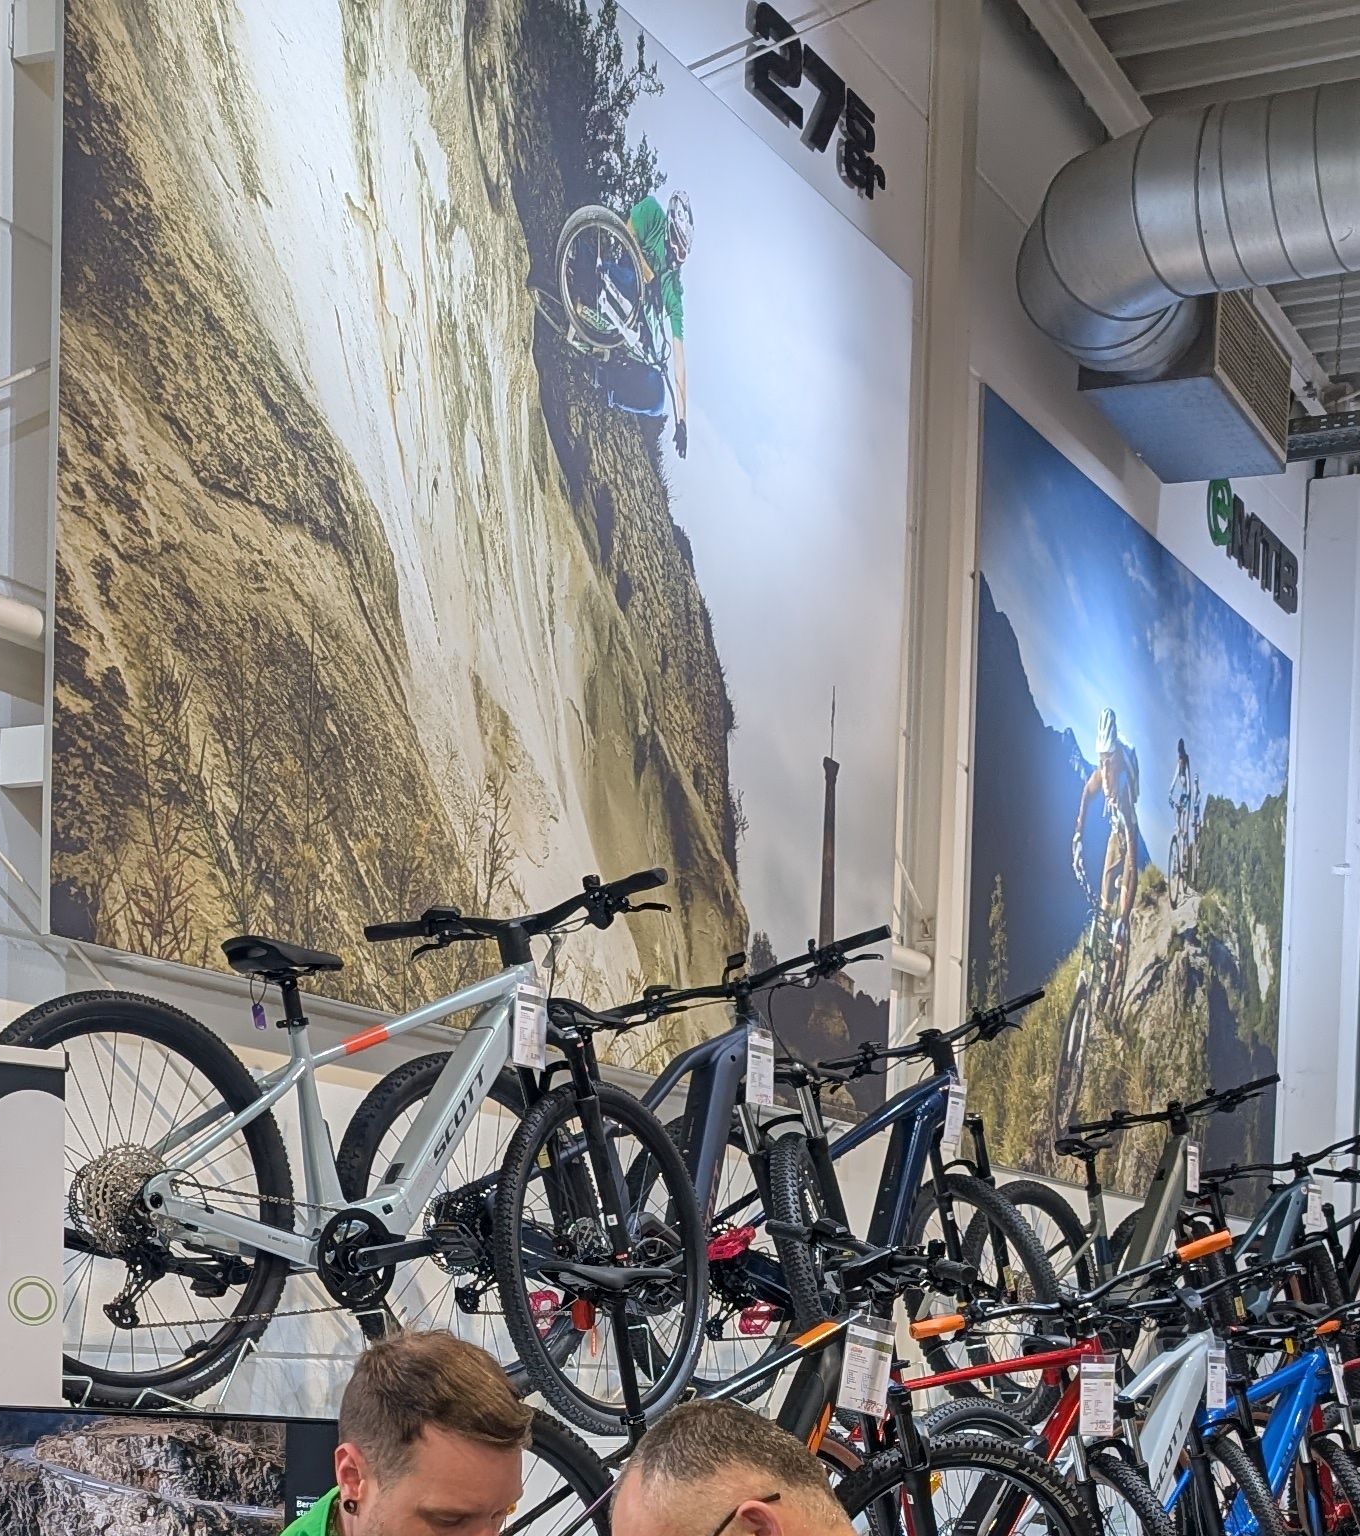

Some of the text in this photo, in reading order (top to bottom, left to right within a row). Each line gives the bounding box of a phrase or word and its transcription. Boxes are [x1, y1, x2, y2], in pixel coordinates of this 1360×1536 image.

[433, 1063, 485, 1167] SCOTT
[970, 1451, 1079, 1518] SMART SAM
